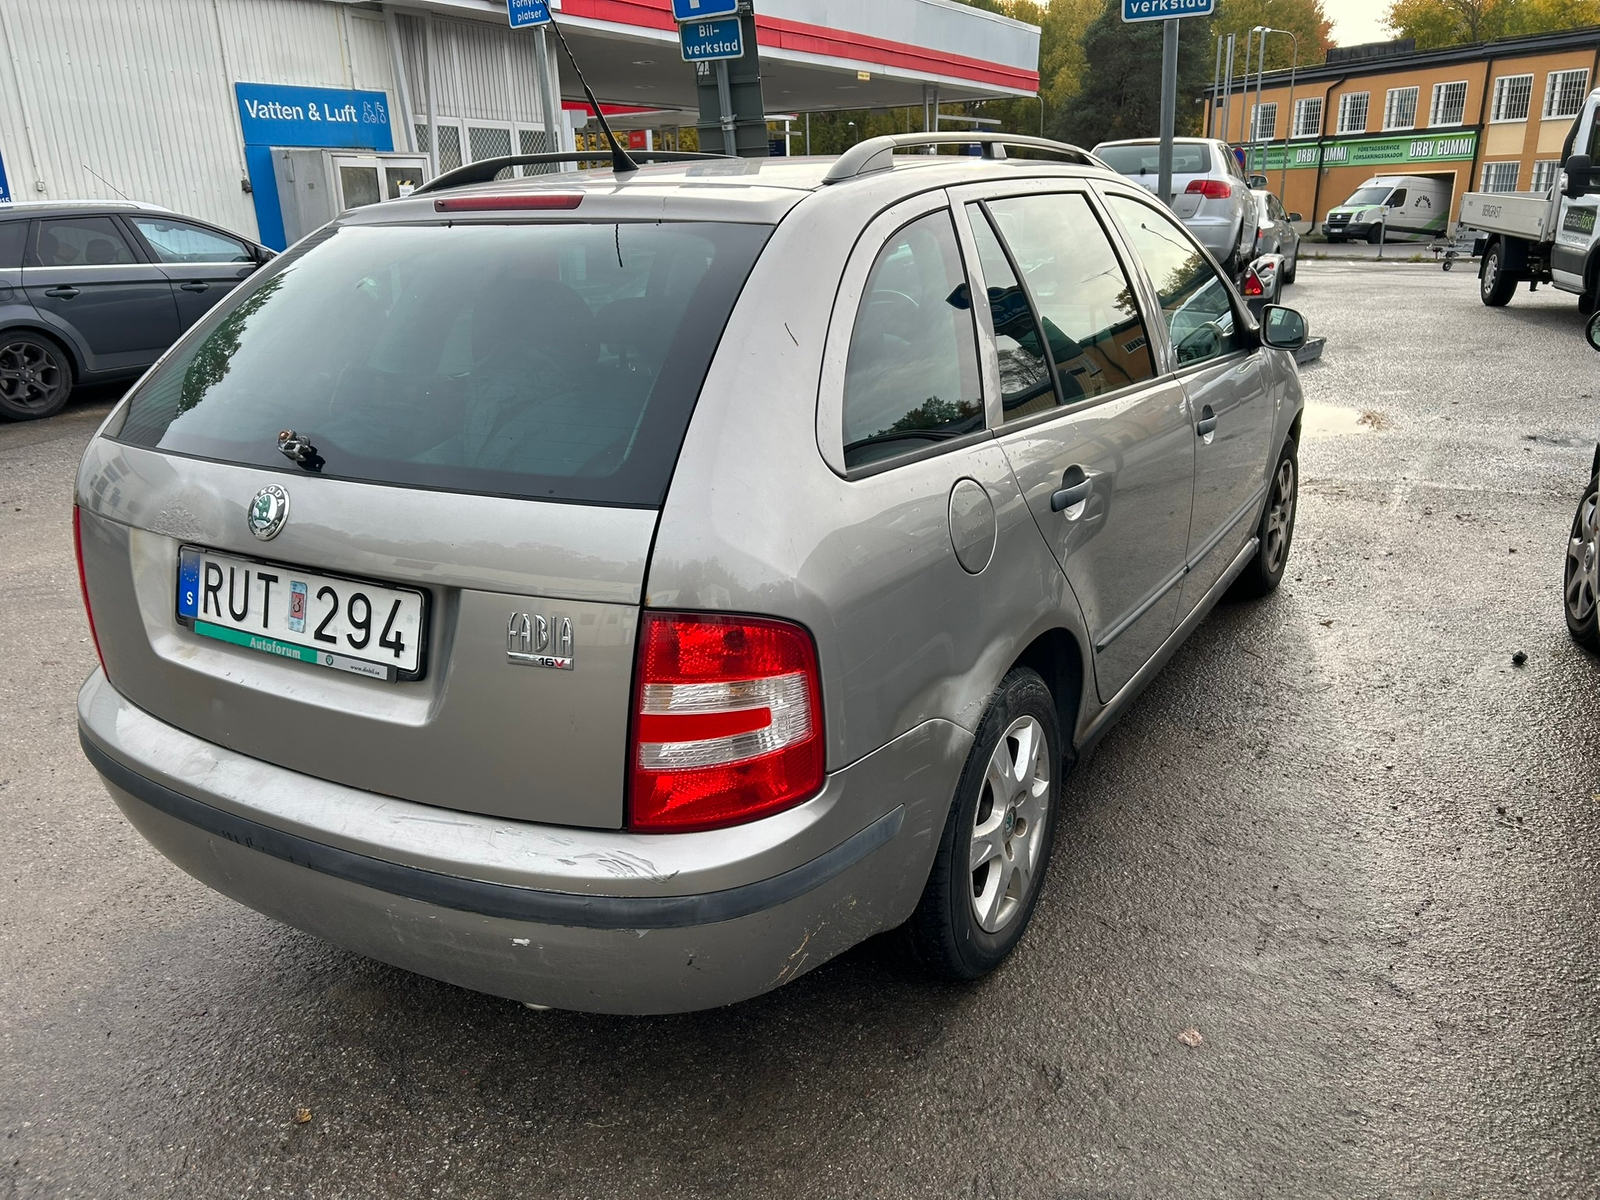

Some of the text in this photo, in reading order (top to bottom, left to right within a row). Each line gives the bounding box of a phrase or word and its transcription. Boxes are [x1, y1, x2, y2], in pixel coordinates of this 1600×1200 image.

[517, 10, 542, 23] platser
[698, 24, 720, 37] Bil-
[686, 39, 739, 55] verkstad
[244, 99, 358, 122] Vatten & Luft
[1296, 146, 1348, 163] ÖRBY UMMI
[1353, 152, 1403, 160] FÖRSÄKRINGSSKADOR
[1357, 144, 1400, 152] FÖRETAGSSERVICE
[1409, 139, 1473, 157] ÖRBY GUMMI
[186, 591, 193, 605] S
[202, 561, 405, 658] RUT 294
[506, 611, 574, 656] FABIA
[249, 636, 301, 660] Autoforum
[537, 657, 565, 669] 16V
